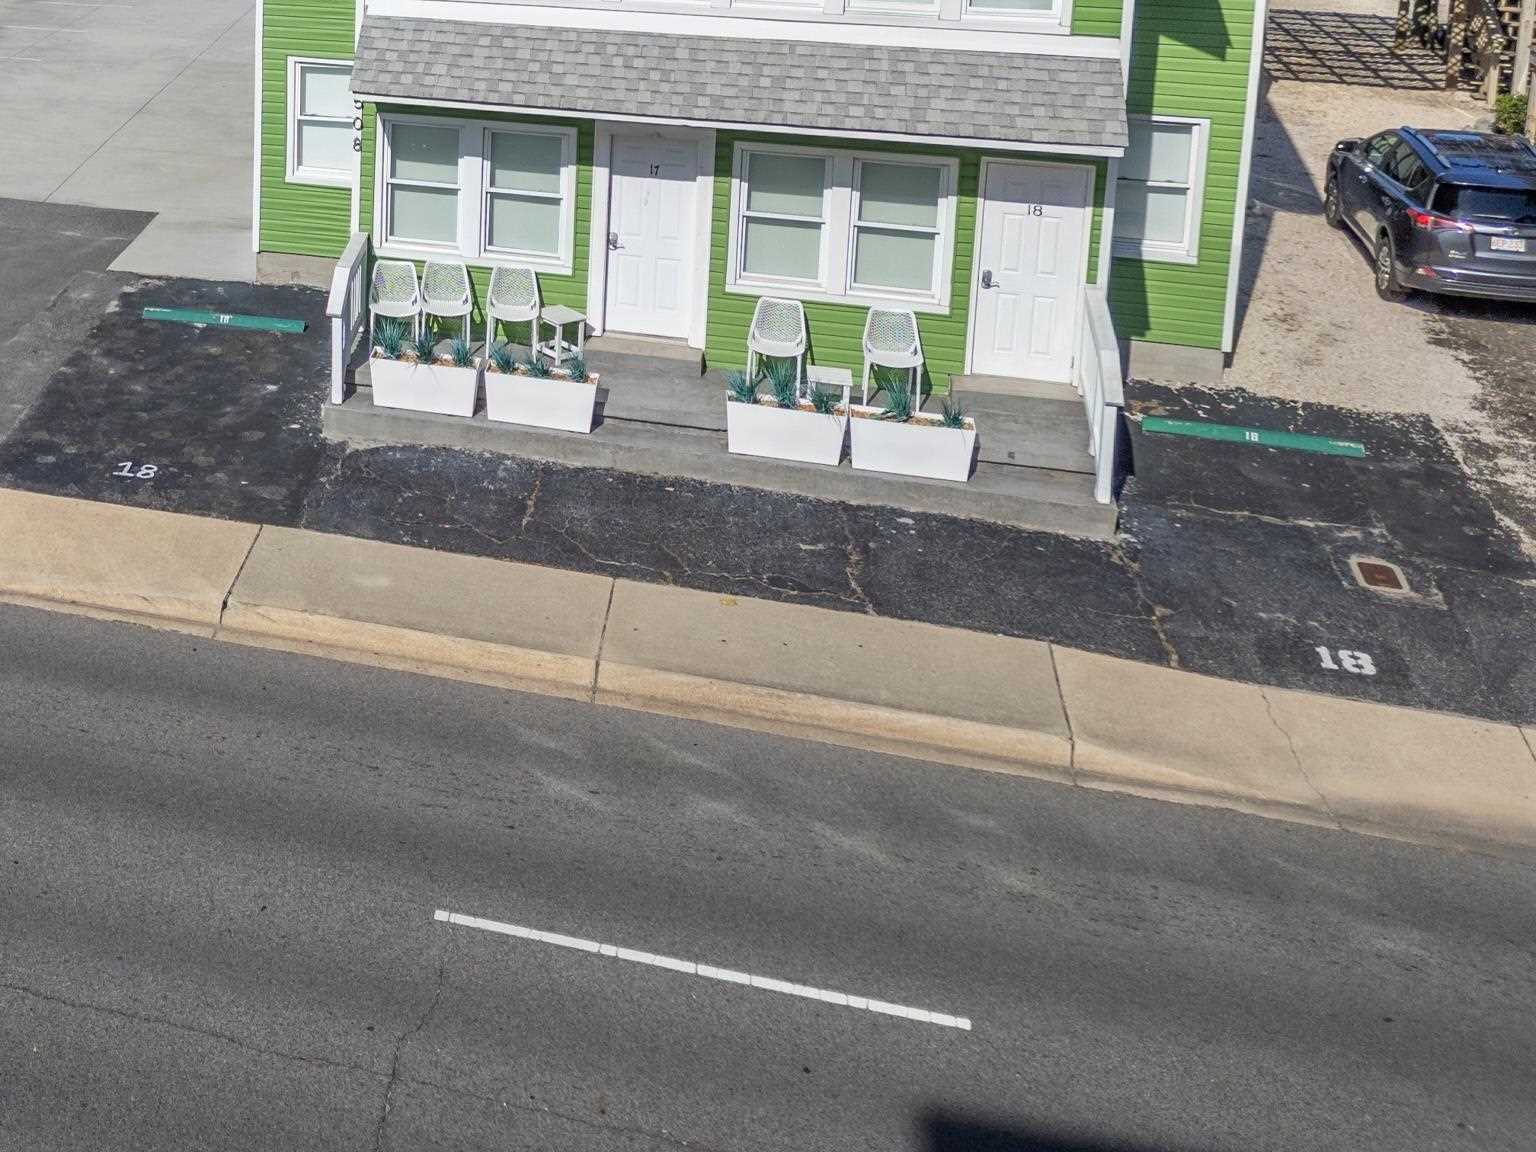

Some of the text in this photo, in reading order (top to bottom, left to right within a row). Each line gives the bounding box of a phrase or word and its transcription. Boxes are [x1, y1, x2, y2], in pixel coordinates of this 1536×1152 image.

[650, 163, 660, 176] 17
[1027, 204, 1043, 216] 18
[1245, 431, 1259, 442] 18
[112, 461, 158, 479] 18
[1314, 646, 1377, 675] 18
